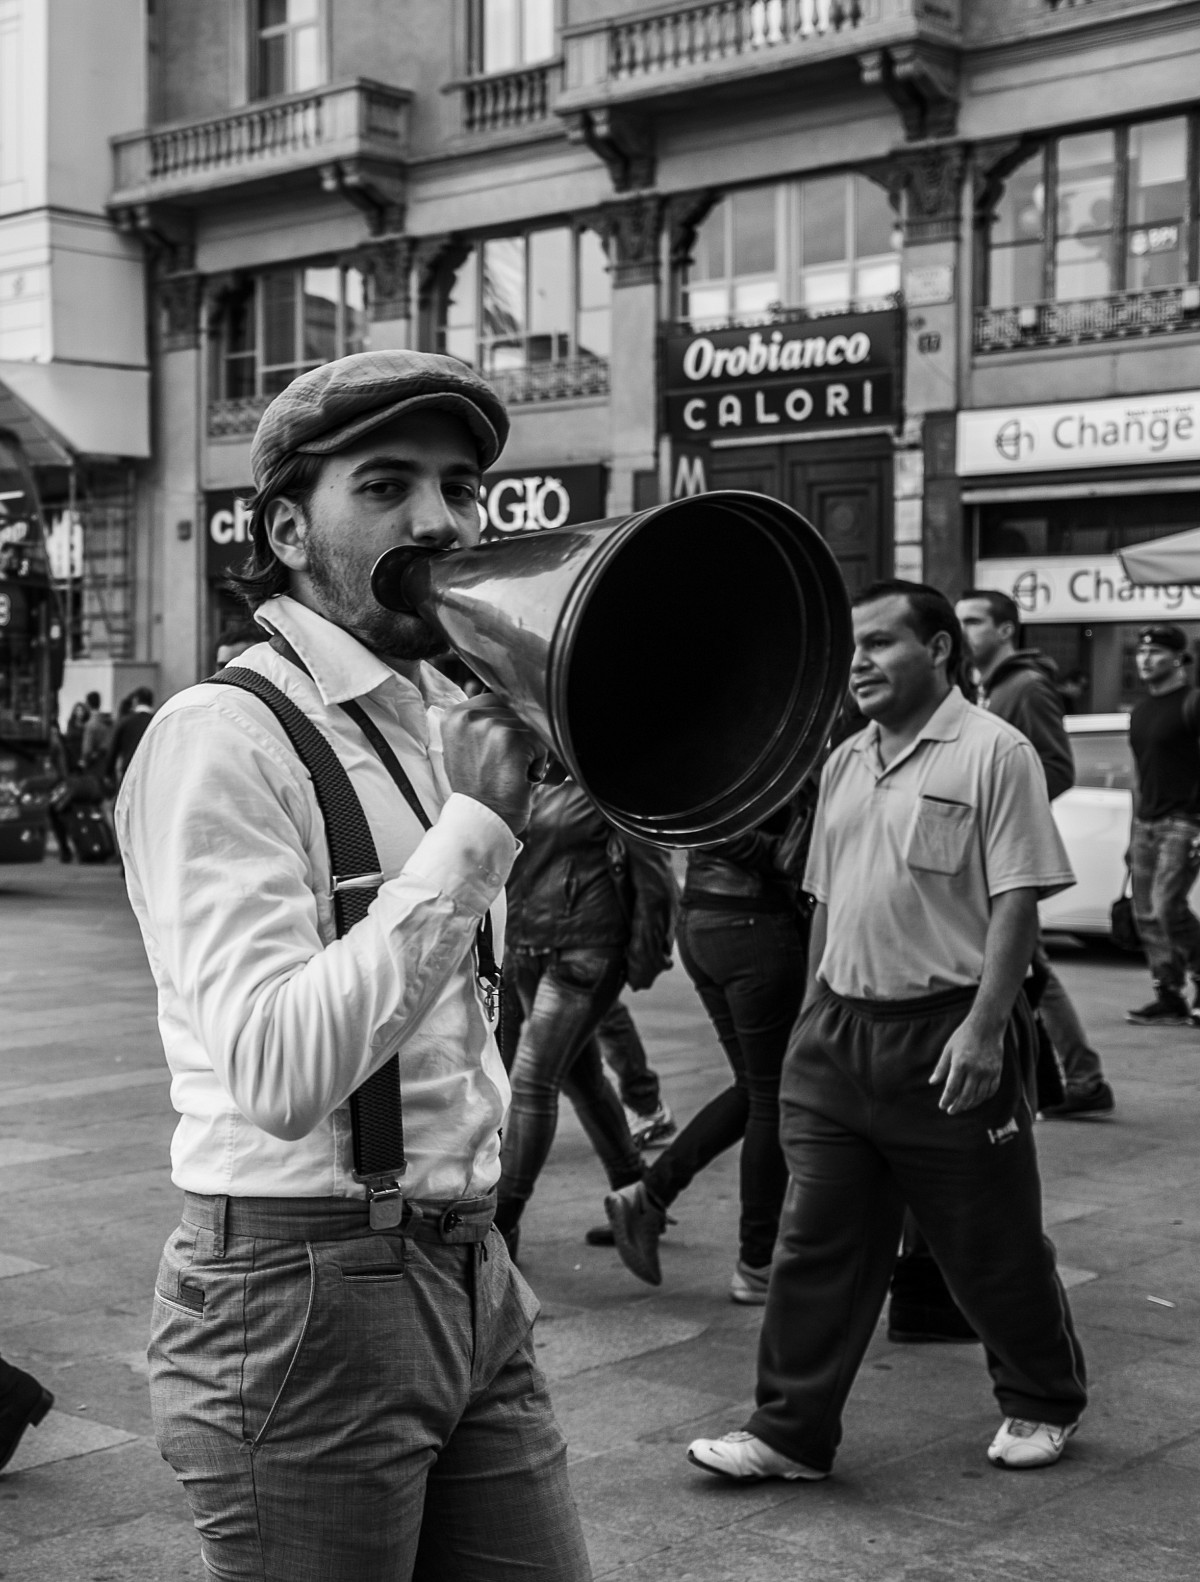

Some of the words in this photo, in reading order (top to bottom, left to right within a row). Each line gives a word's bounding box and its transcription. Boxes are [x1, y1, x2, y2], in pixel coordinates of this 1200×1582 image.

[683, 330, 871, 381] Orobianco
[683, 379, 873, 430] CALORI
[1052, 413, 1194, 452] Change
